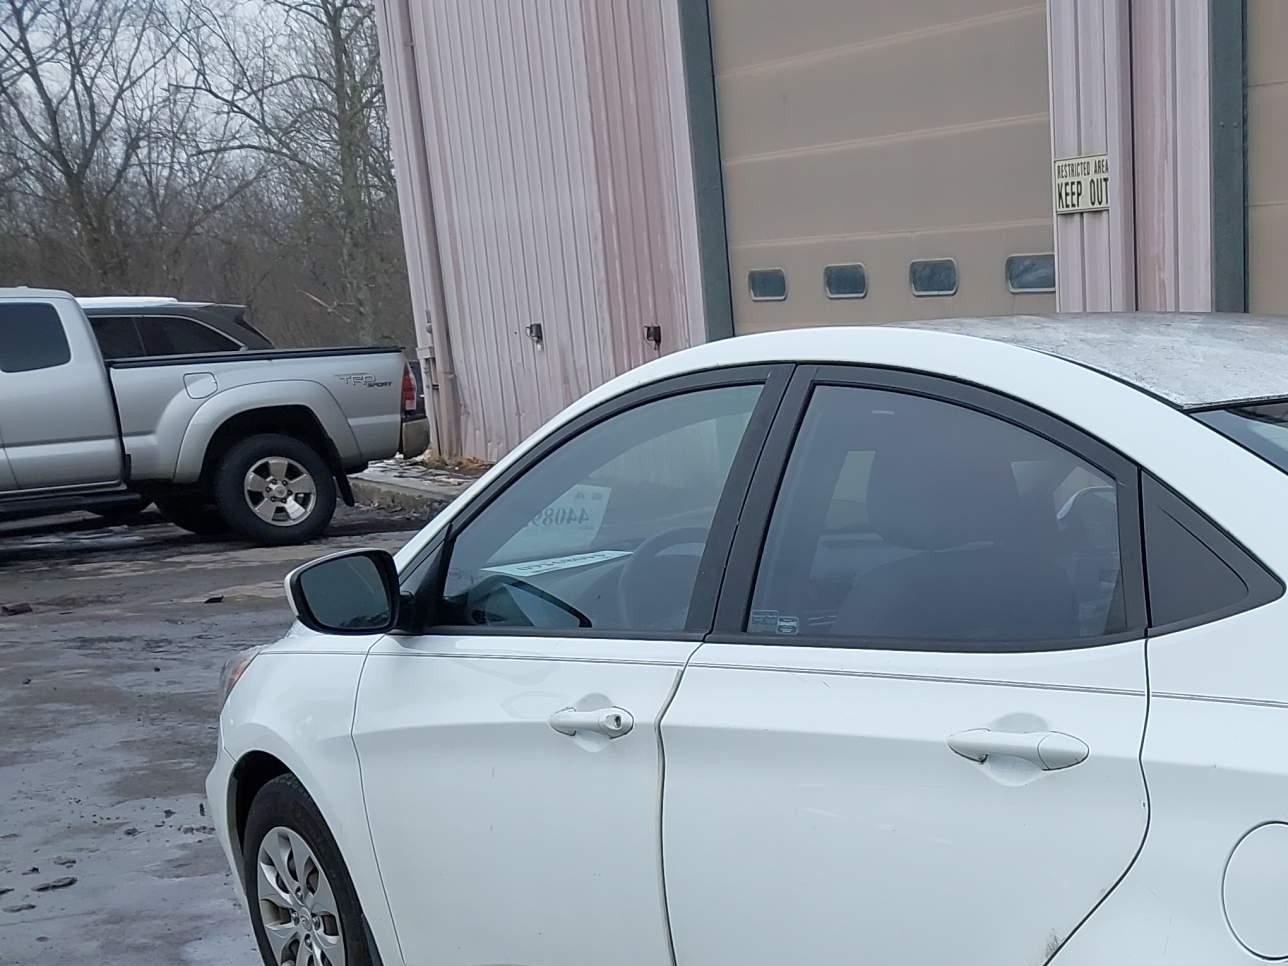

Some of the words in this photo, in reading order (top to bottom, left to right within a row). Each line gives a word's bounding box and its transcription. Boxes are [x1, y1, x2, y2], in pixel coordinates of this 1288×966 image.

[1057, 162, 1090, 178] RESTRICTED
[1094, 159, 1109, 174] AREA
[1057, 181, 1083, 208] KEEP
[1089, 178, 1109, 206] OUT
[339, 376, 376, 385] TRD
